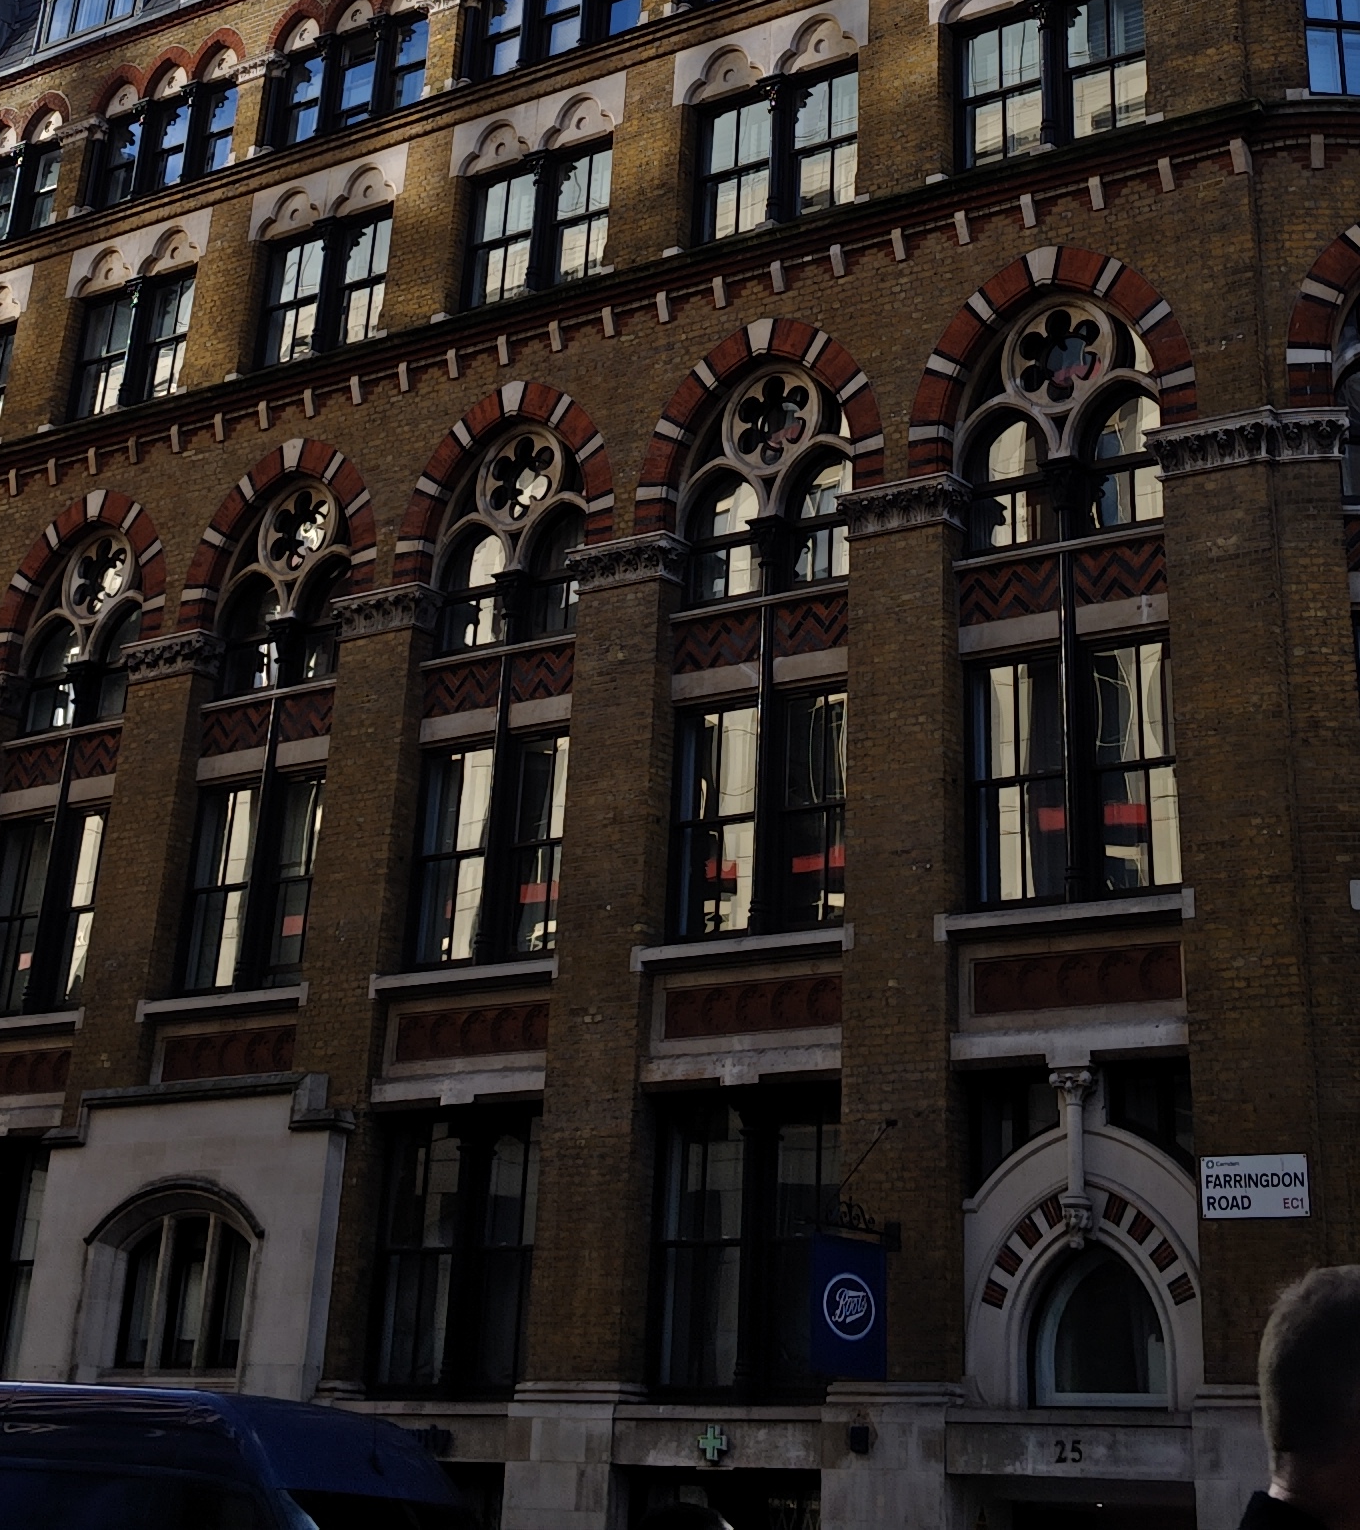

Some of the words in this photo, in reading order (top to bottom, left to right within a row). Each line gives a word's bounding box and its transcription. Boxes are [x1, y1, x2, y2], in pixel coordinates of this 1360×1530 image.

[1205, 1172, 1305, 1189] FARRINGDON
[1207, 1195, 1252, 1211] ROAD
[1283, 1197, 1304, 1209] EC1
[832, 1287, 868, 1324] Boots
[1054, 1440, 1083, 1463] 25
